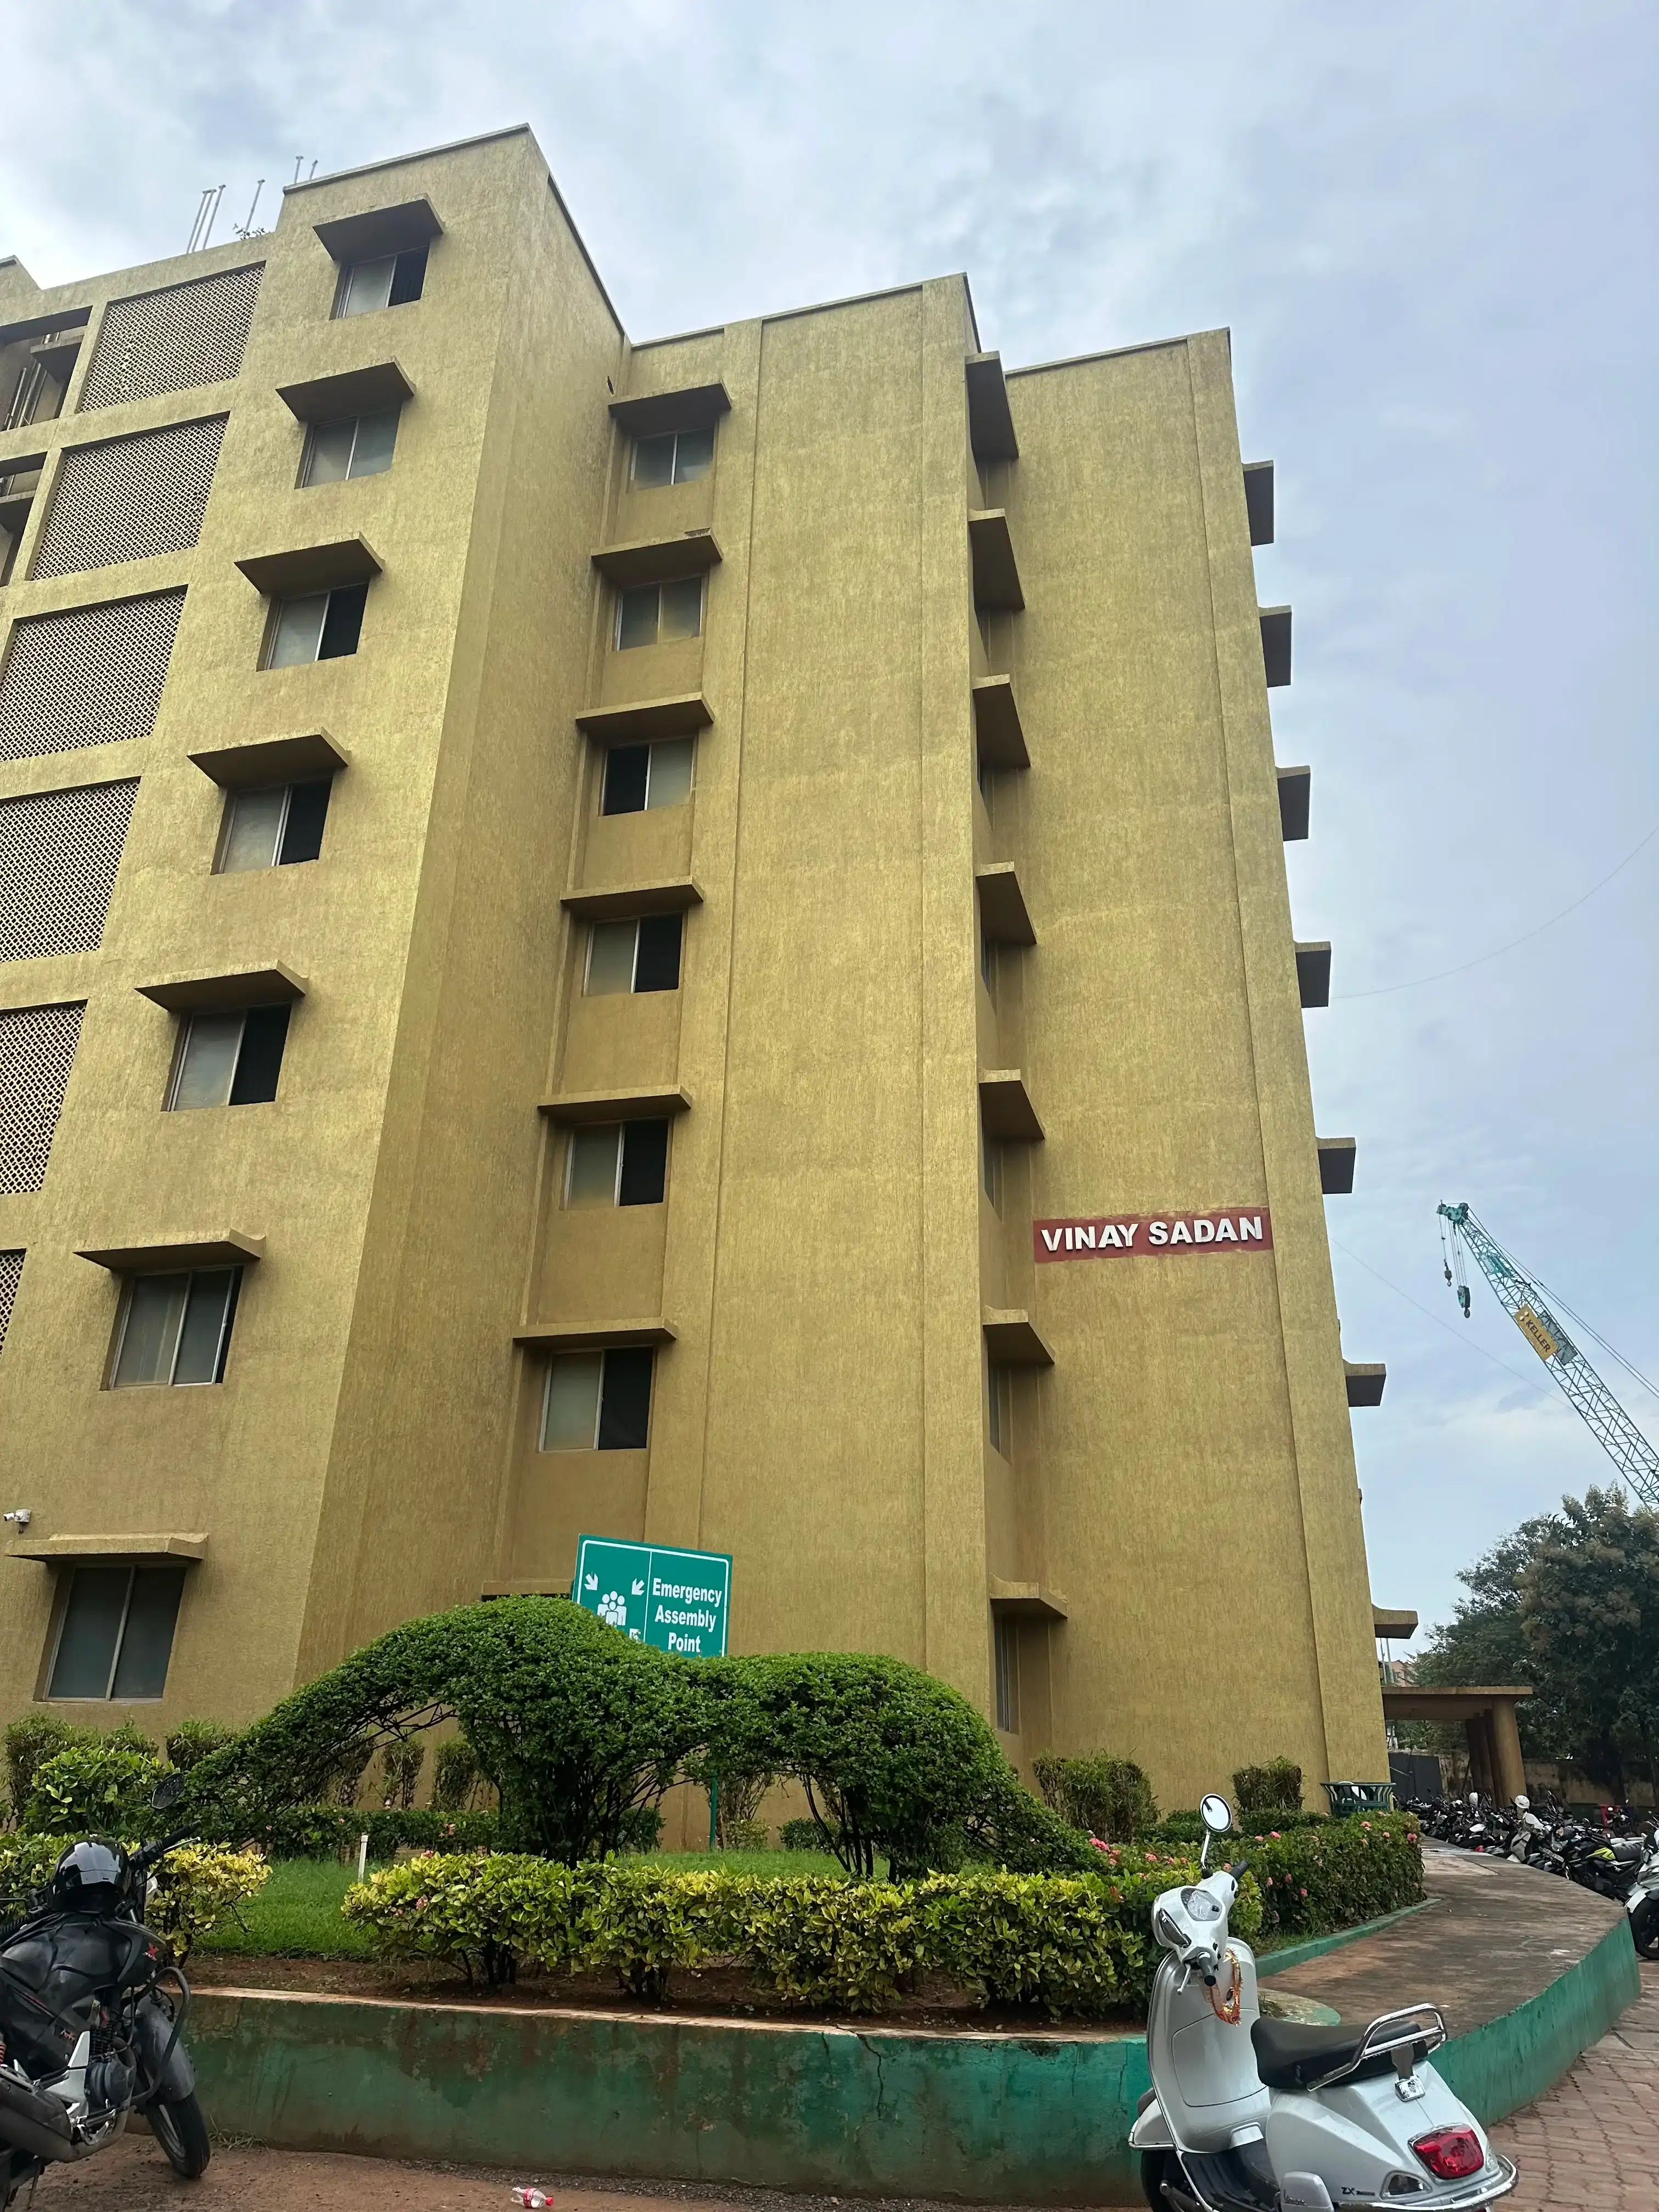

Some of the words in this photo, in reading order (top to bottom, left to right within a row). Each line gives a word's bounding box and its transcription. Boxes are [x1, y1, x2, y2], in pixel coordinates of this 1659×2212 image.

[1041, 1223, 1139, 1251] VINAY
[1148, 1216, 1262, 1245] SADAN
[1526, 1319, 1550, 1352] KELLER
[652, 1577, 722, 1607] Emergency
[654, 1604, 716, 1633] Assembly
[668, 1632, 701, 1652] Point
[1341, 2186, 1356, 2195] ZX
